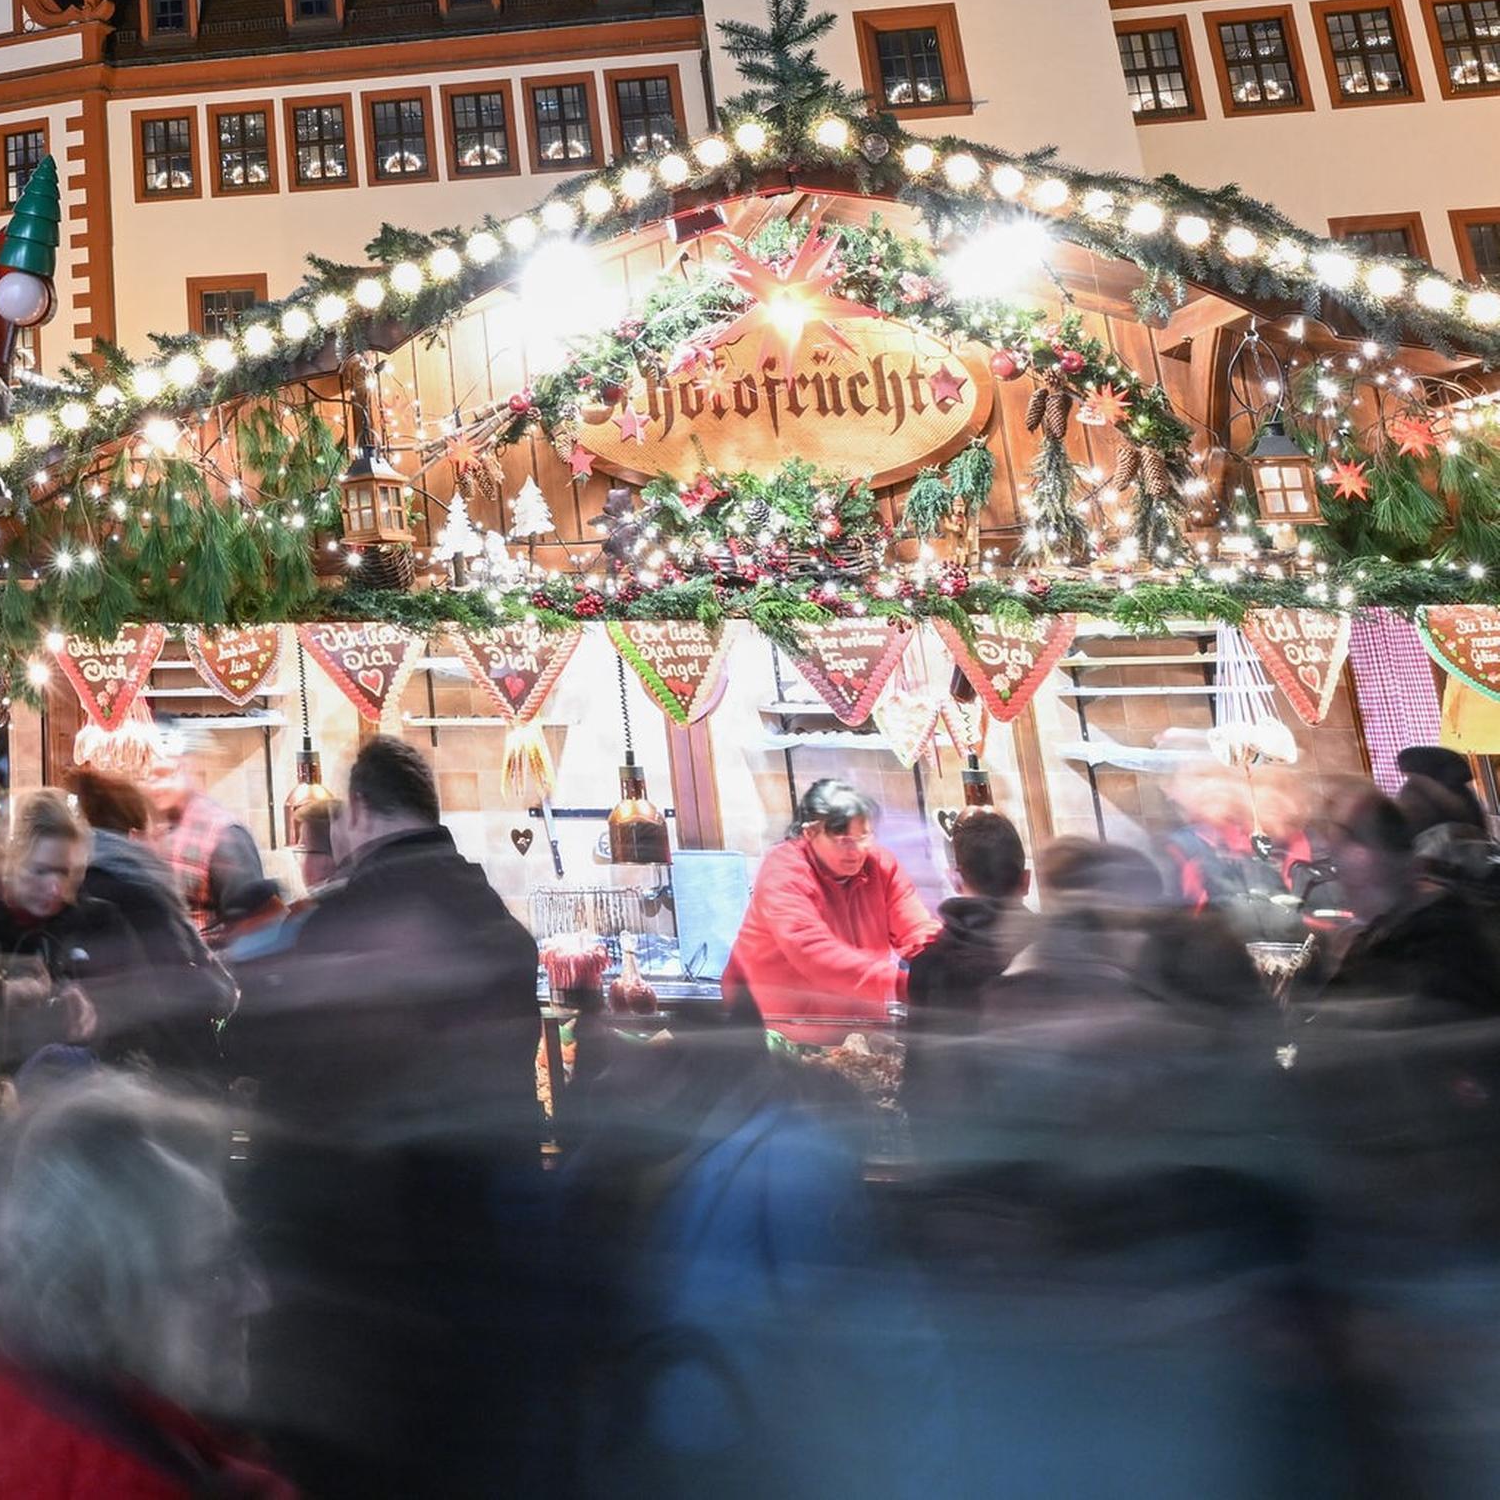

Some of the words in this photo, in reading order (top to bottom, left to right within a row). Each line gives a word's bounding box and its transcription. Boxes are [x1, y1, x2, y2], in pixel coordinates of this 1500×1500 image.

[342, 646, 398, 670] Dich
[483, 646, 539, 673] Dich
[636, 642, 678, 661] Dich
[675, 642, 714, 657] mein
[973, 640, 1034, 668] Dich
[1283, 640, 1332, 665] Dich
[78, 657, 127, 682] Dich
[655, 658, 703, 682] Engel
